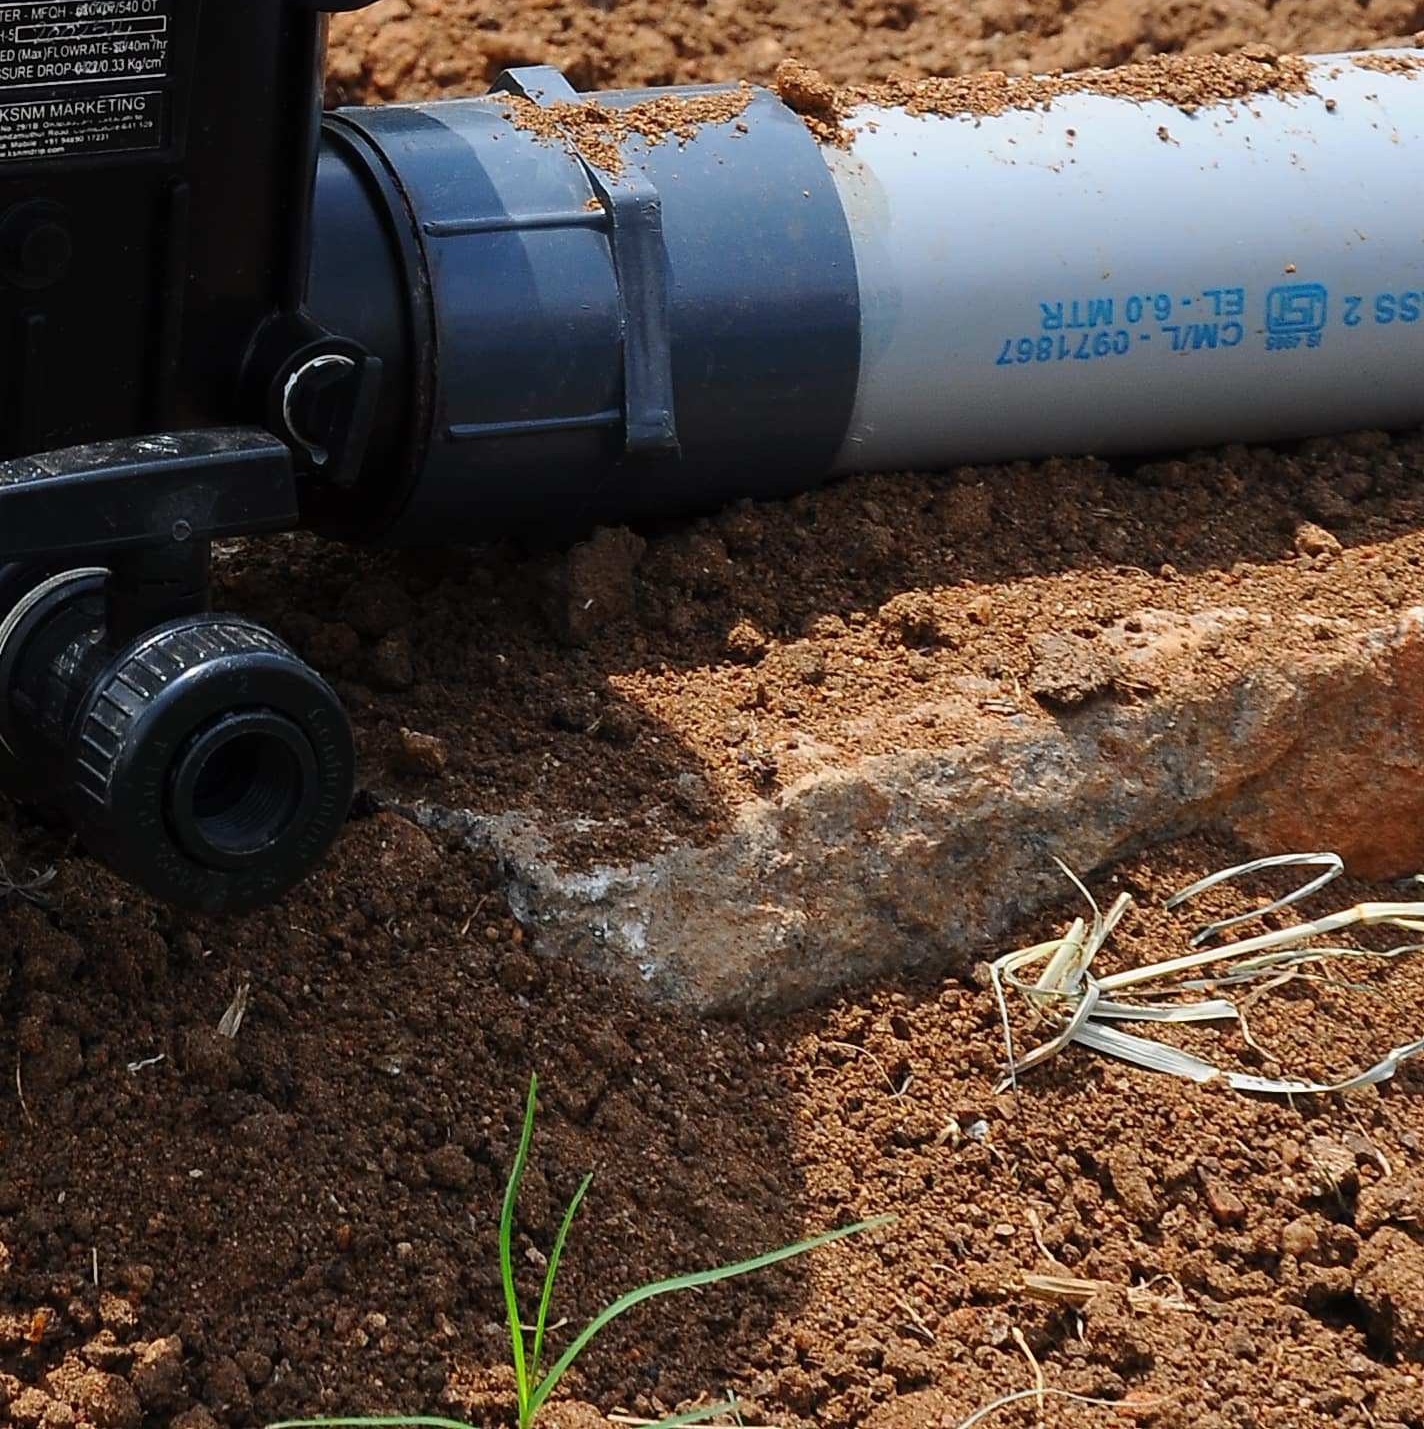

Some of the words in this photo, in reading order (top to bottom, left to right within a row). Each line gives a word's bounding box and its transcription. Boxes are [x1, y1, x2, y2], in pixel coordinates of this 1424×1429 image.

[31, 5, 66, 21] MFQH
[49, 96, 146, 117] MARKETING
[1039, 297, 1114, 331] MTR
[1125, 293, 1172, 324] 6.0
[1343, 294, 1363, 327] 2
[1375, 291, 1424, 325] SS
[995, 329, 1130, 366] 0971867
[1161, 322, 1244, 352] CM/L
